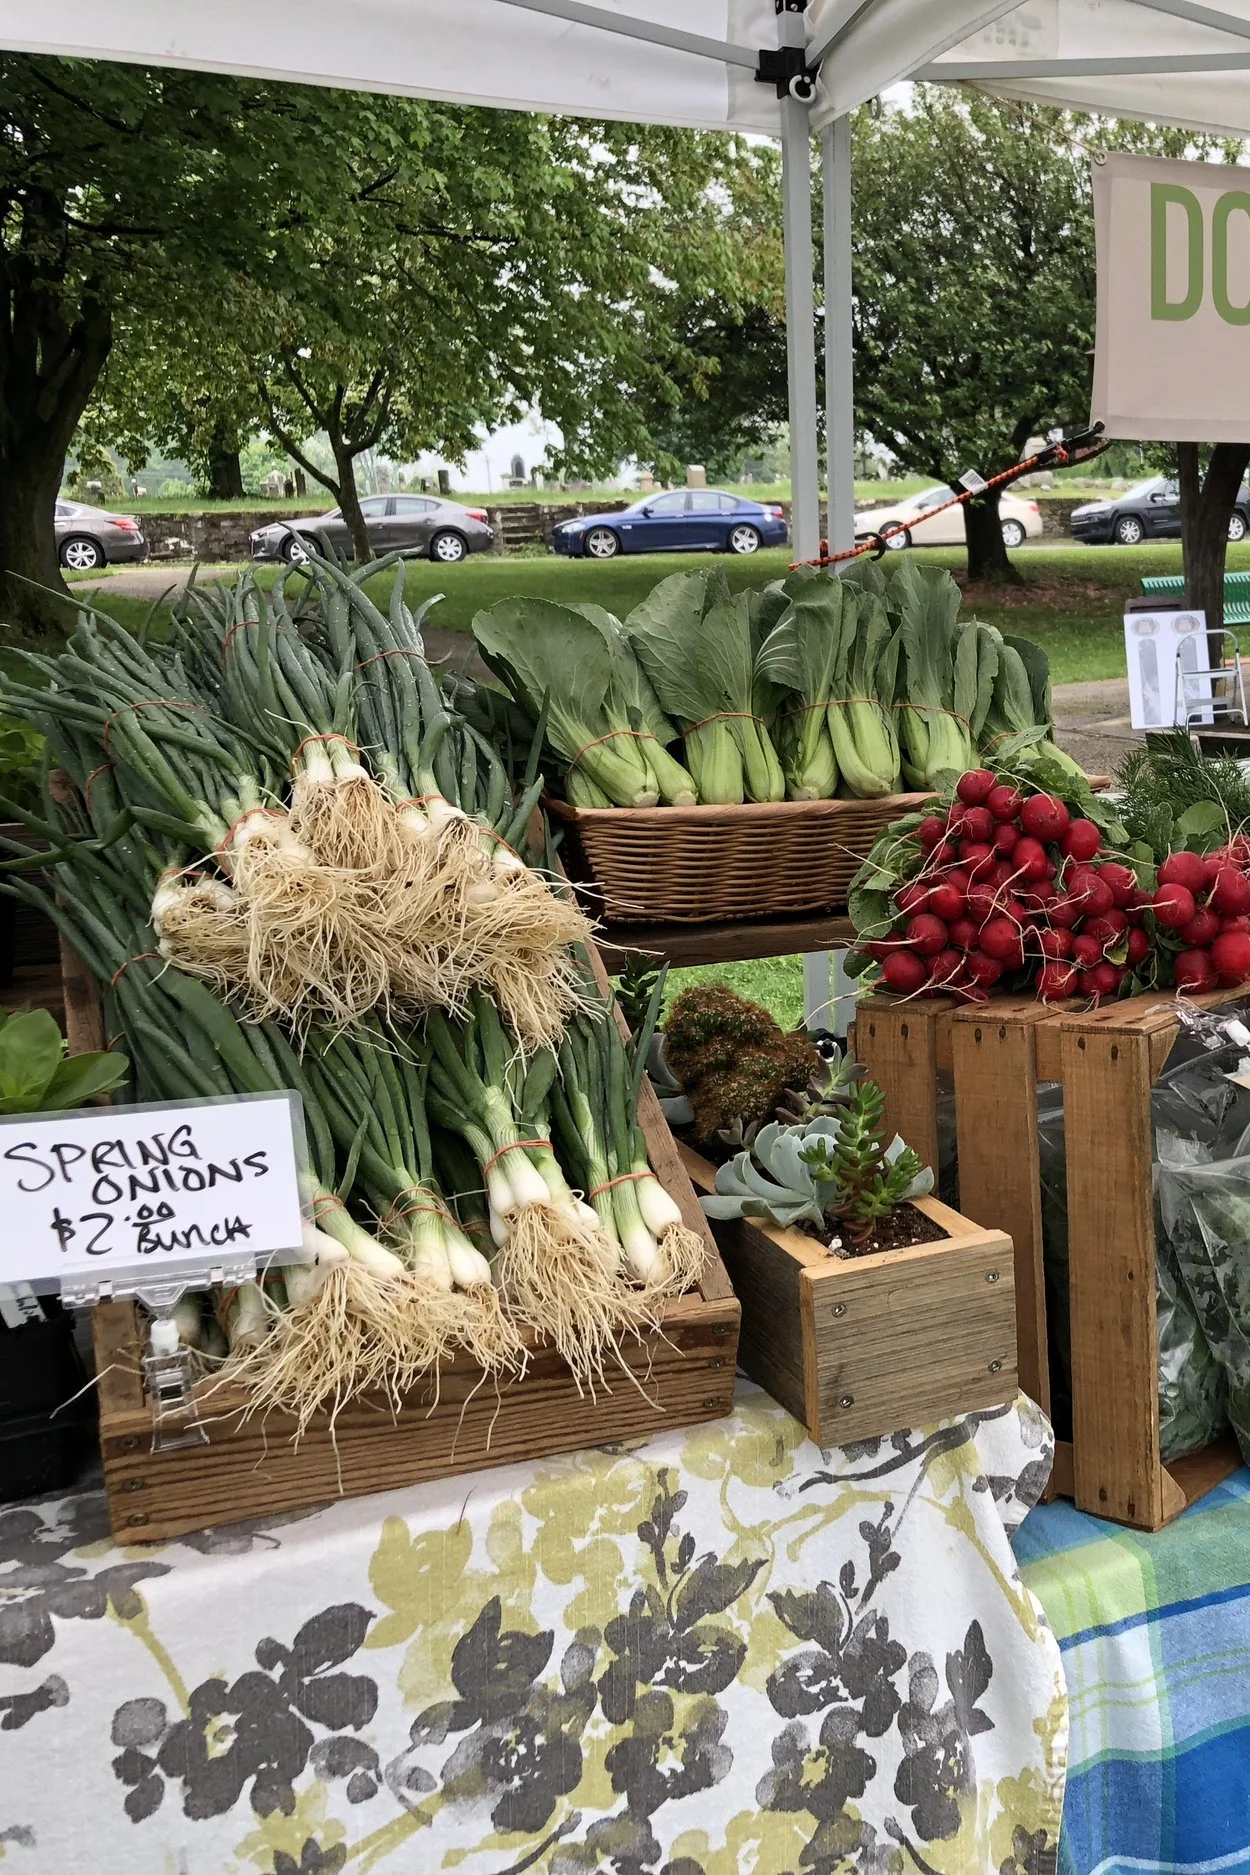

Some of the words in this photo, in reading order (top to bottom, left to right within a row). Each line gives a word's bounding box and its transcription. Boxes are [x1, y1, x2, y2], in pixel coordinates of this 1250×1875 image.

[5, 1124, 203, 1192] SPRING
[92, 1151, 270, 1205] ONIONS
[51, 1201, 176, 1256] $2.00
